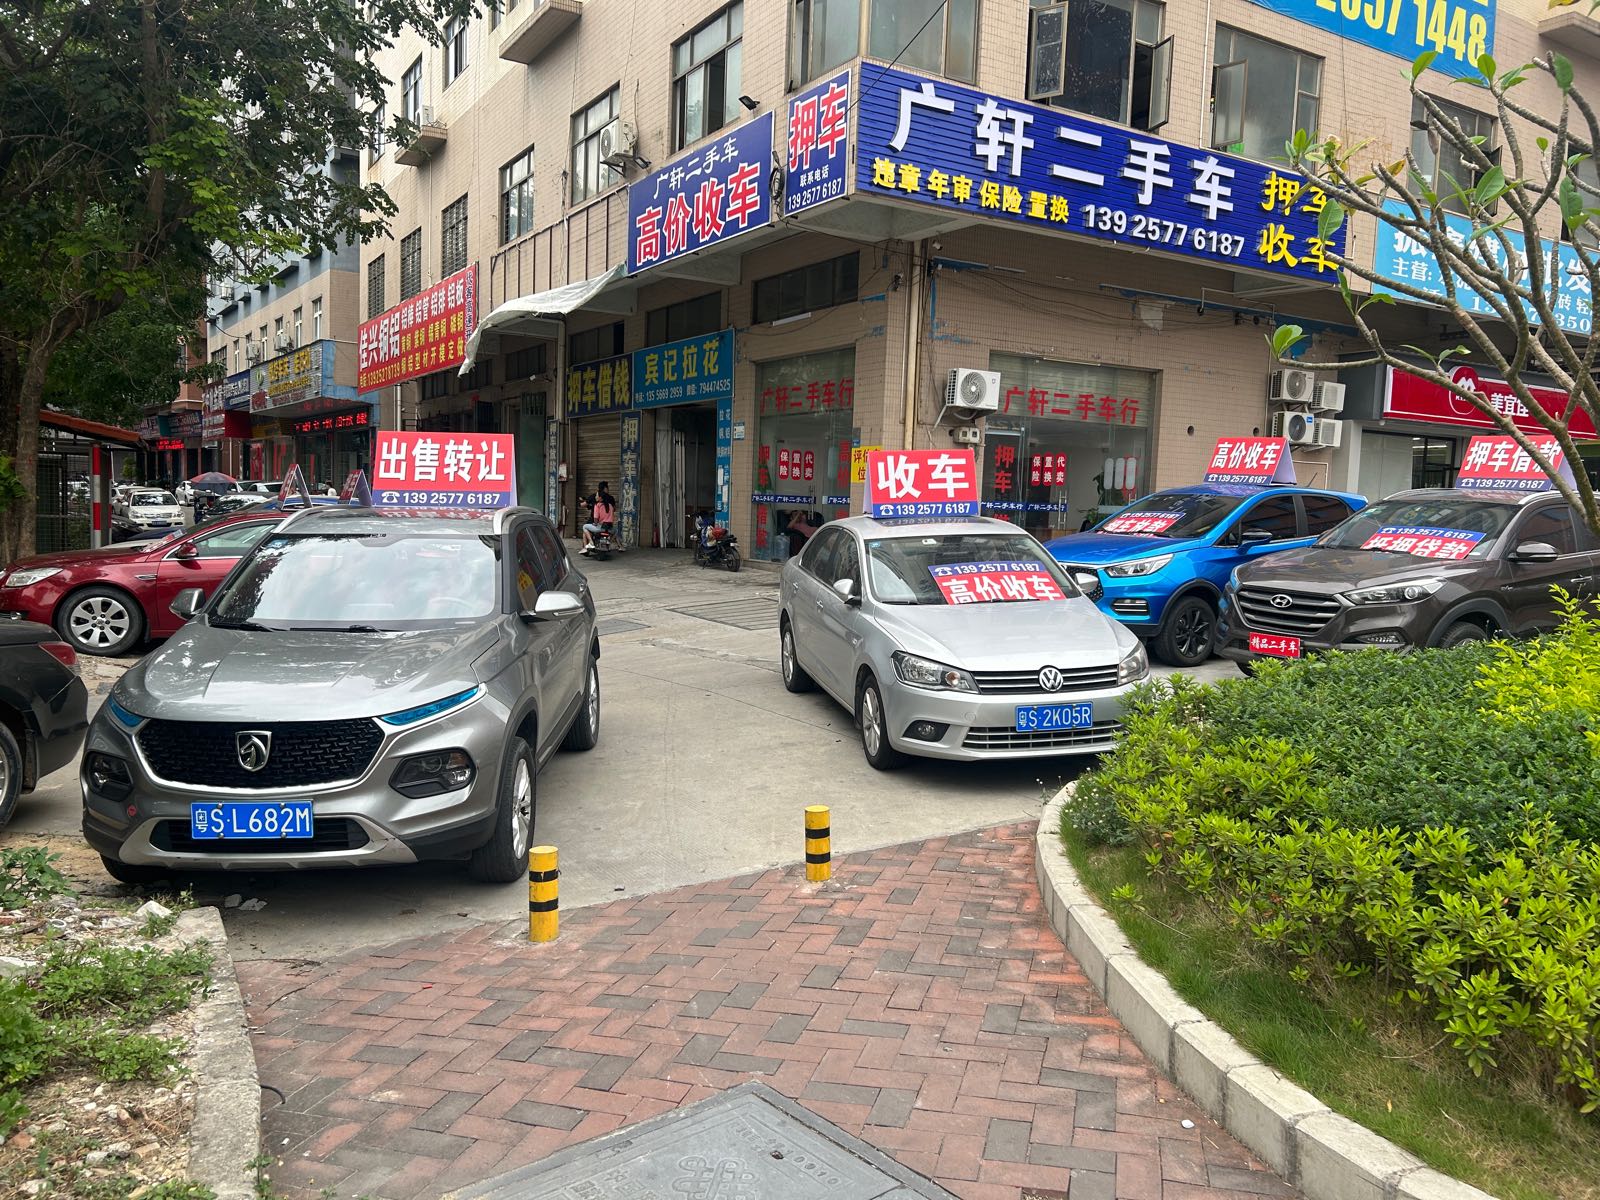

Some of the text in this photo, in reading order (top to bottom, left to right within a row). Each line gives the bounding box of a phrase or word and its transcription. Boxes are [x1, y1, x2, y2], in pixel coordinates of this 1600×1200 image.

[1413, 0, 1487, 68] 1448
[789, 83, 848, 172] 押车
[889, 82, 1235, 221] 广轩二手车
[653, 137, 739, 200] 广轩二手车
[799, 164, 830, 188] 联系电话
[787, 178, 842, 211] 139 2577 6187
[873, 157, 1070, 223] 违章 年审 保险 置换
[635, 162, 761, 266] 高价收车
[1084, 204, 1245, 257] 139 2577 6187
[1259, 222, 1339, 273] 收车
[645, 337, 719, 386] 宾记拉花
[567, 358, 630, 413] 押车借钱
[760, 378, 855, 414] 广轩二手车行
[1003, 386, 1139, 425] 广轩二手车行
[378, 437, 505, 483] 出售转让
[780, 451, 789, 477] 保险
[792, 453, 801, 478] 置换
[804, 455, 813, 478] 代卖
[1031, 456, 1041, 483] 保险
[1043, 456, 1053, 483] 置换
[1056, 456, 1066, 483] 代卖
[1211, 442, 1280, 470] 高价收车
[877, 454, 970, 498] 收车
[1230, 475, 1249, 483] 2577
[1248, 475, 1267, 484] 6187
[1475, 479, 1545, 489] 139 2577 6187
[403, 493, 500, 505] 139 2577 6187
[896, 503, 970, 515] 139 2577 6187
[1414, 530, 1444, 538] 2577
[1443, 532, 1474, 540] 6187
[954, 562, 1040, 574] 139 2577 6187
[942, 574, 1062, 604] 高价收车
[1250, 636, 1298, 654] 精品二手车
